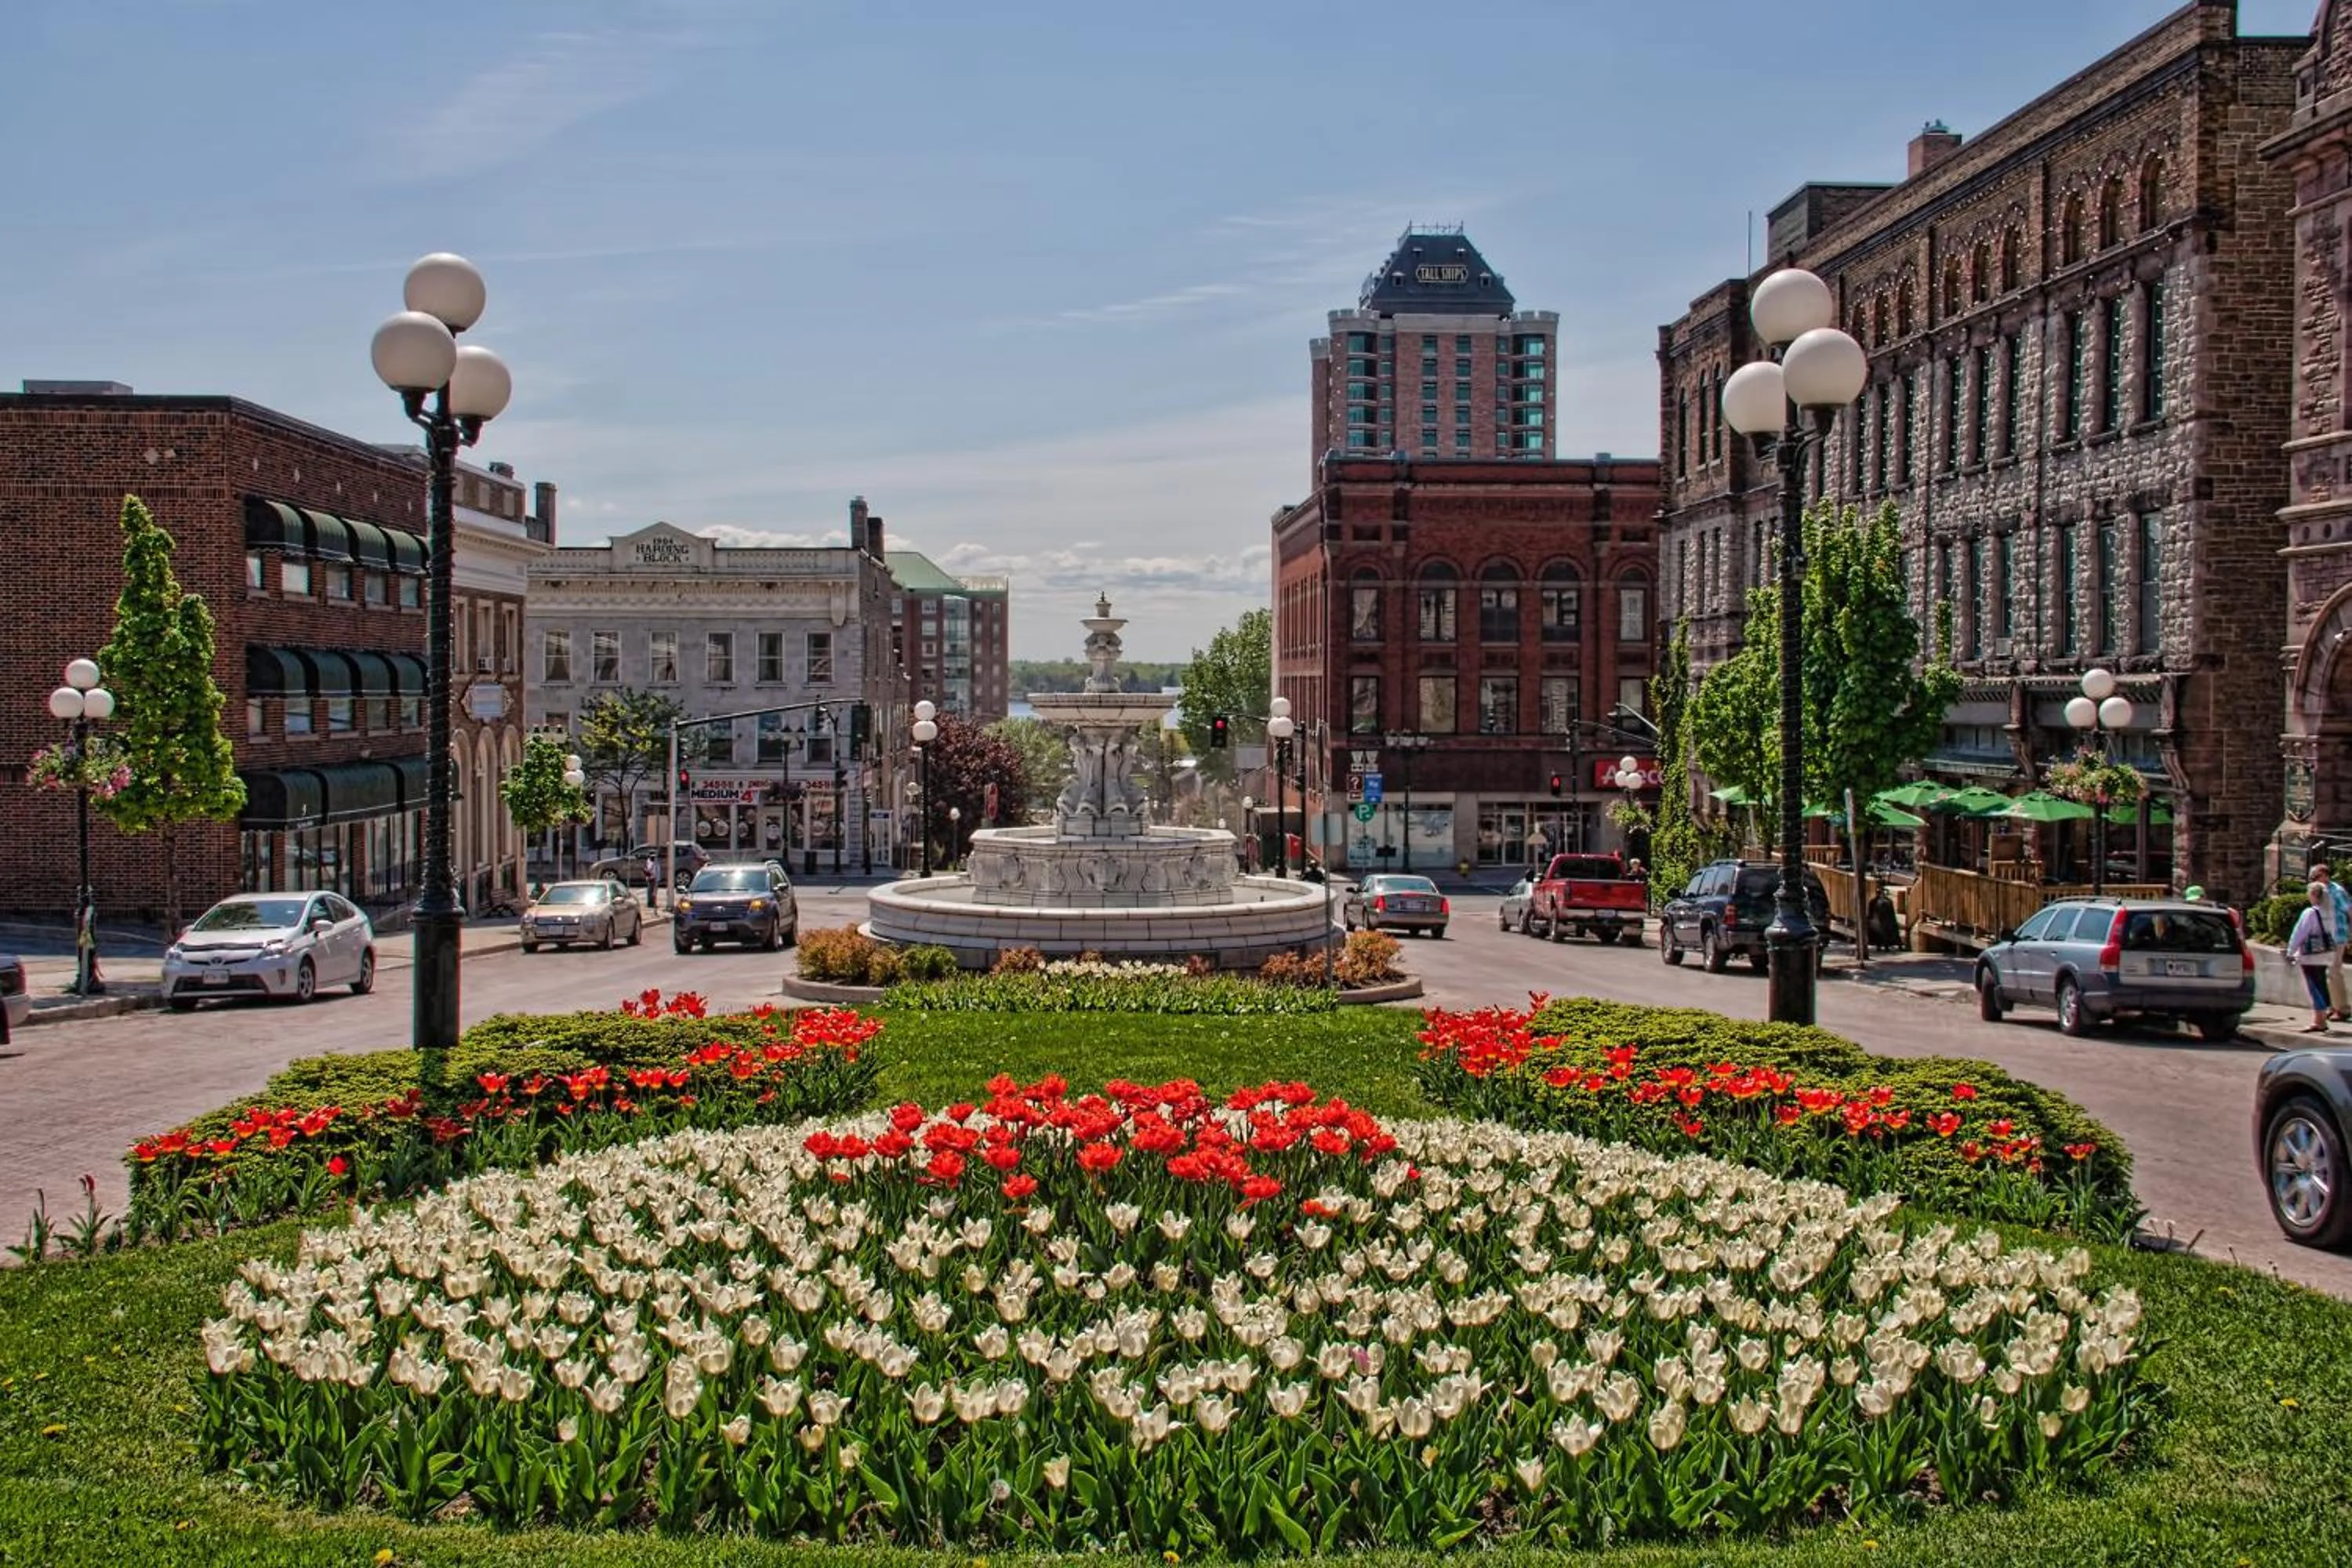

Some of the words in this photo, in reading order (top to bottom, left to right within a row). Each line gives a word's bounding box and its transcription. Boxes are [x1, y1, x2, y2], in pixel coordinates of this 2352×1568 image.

[1421, 267, 1439, 280] TALL
[1442, 267, 1464, 280] SHIPS
[636, 543, 689, 554] HARDING
[644, 554, 681, 563] BLOCK
[691, 789, 739, 799] MEDIUM
